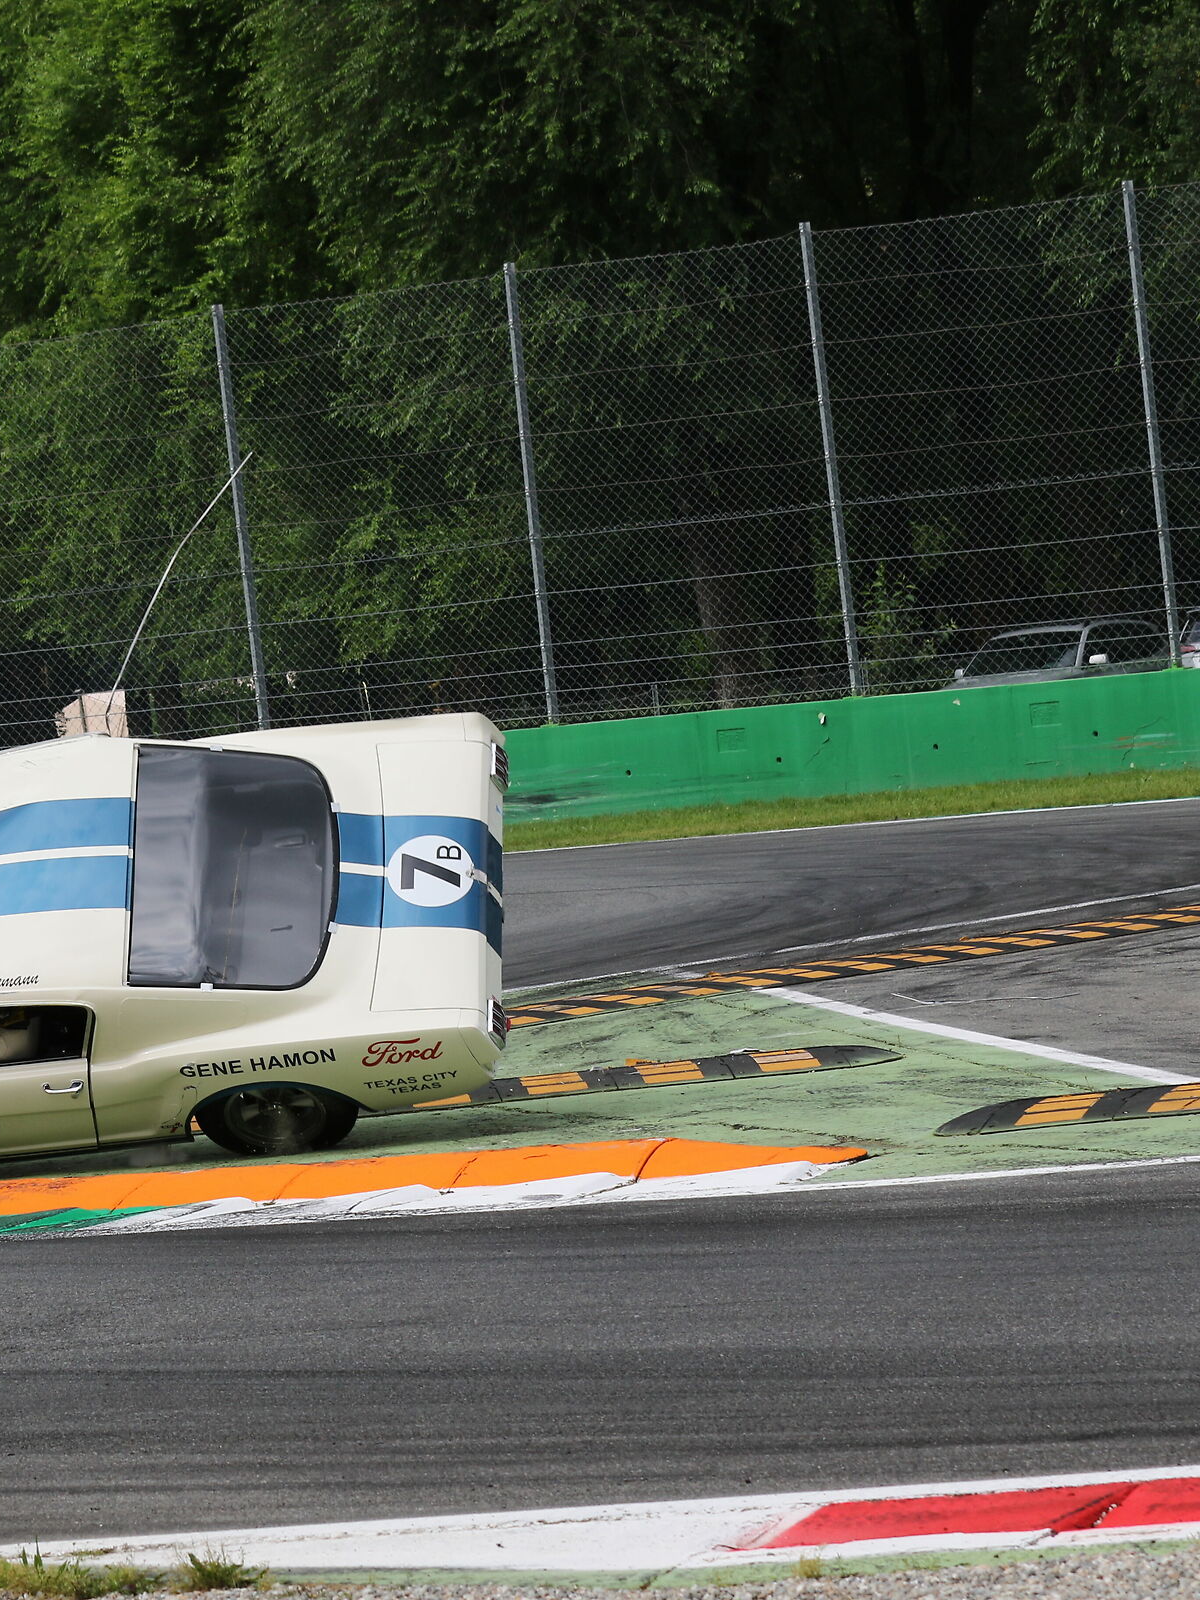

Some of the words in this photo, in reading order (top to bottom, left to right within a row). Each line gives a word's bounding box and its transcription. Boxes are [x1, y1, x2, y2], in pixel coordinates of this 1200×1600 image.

[179, 1059, 244, 1078] GENE
[250, 1048, 337, 1072] HAMON
[361, 1037, 444, 1068] Ford
[363, 1076, 418, 1089] TEXAS
[422, 1070, 458, 1082] CITY
[388, 1082, 442, 1095] TEXAS
